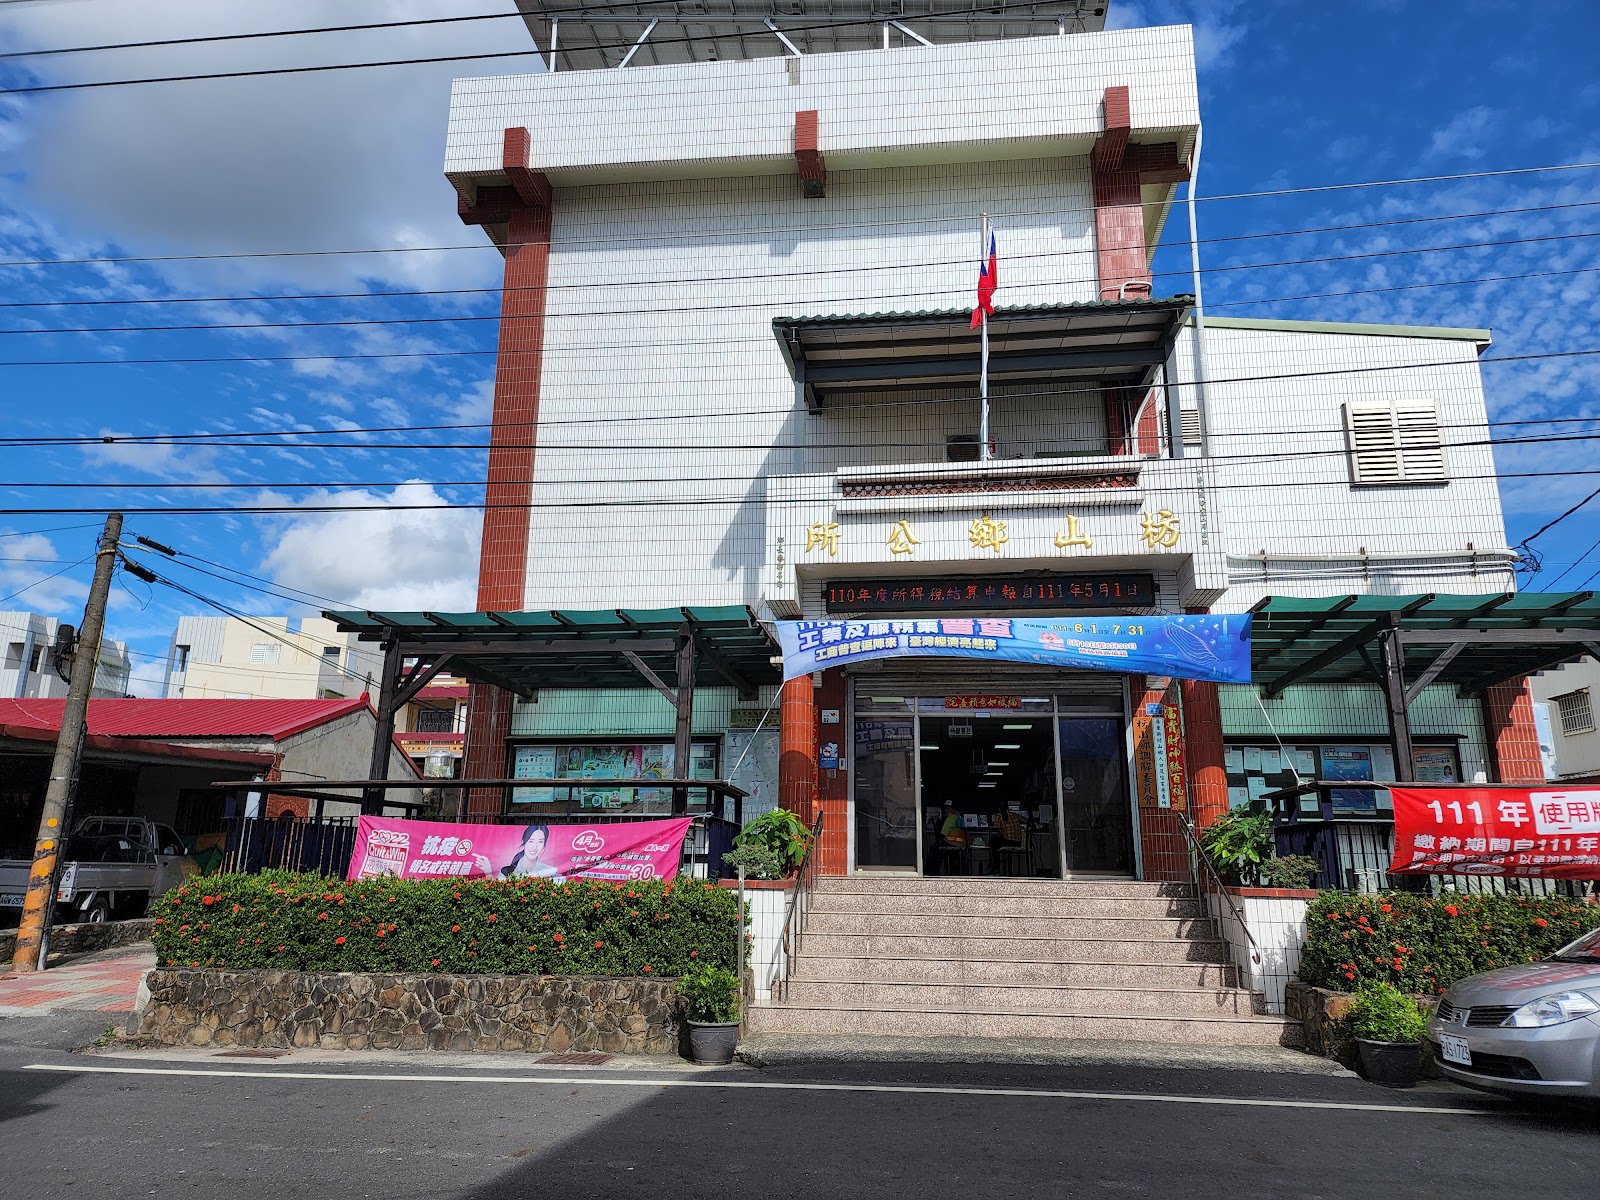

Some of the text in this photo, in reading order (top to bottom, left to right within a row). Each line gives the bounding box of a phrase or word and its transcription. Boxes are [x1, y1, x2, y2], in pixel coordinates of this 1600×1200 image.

[800, 619, 1013, 650] 工業及服務業普查
[1136, 720, 1155, 805] 枋山鄉調解委員會
[369, 845, 406, 861] Quit&Win
[421, 836, 459, 856] 抗疫
